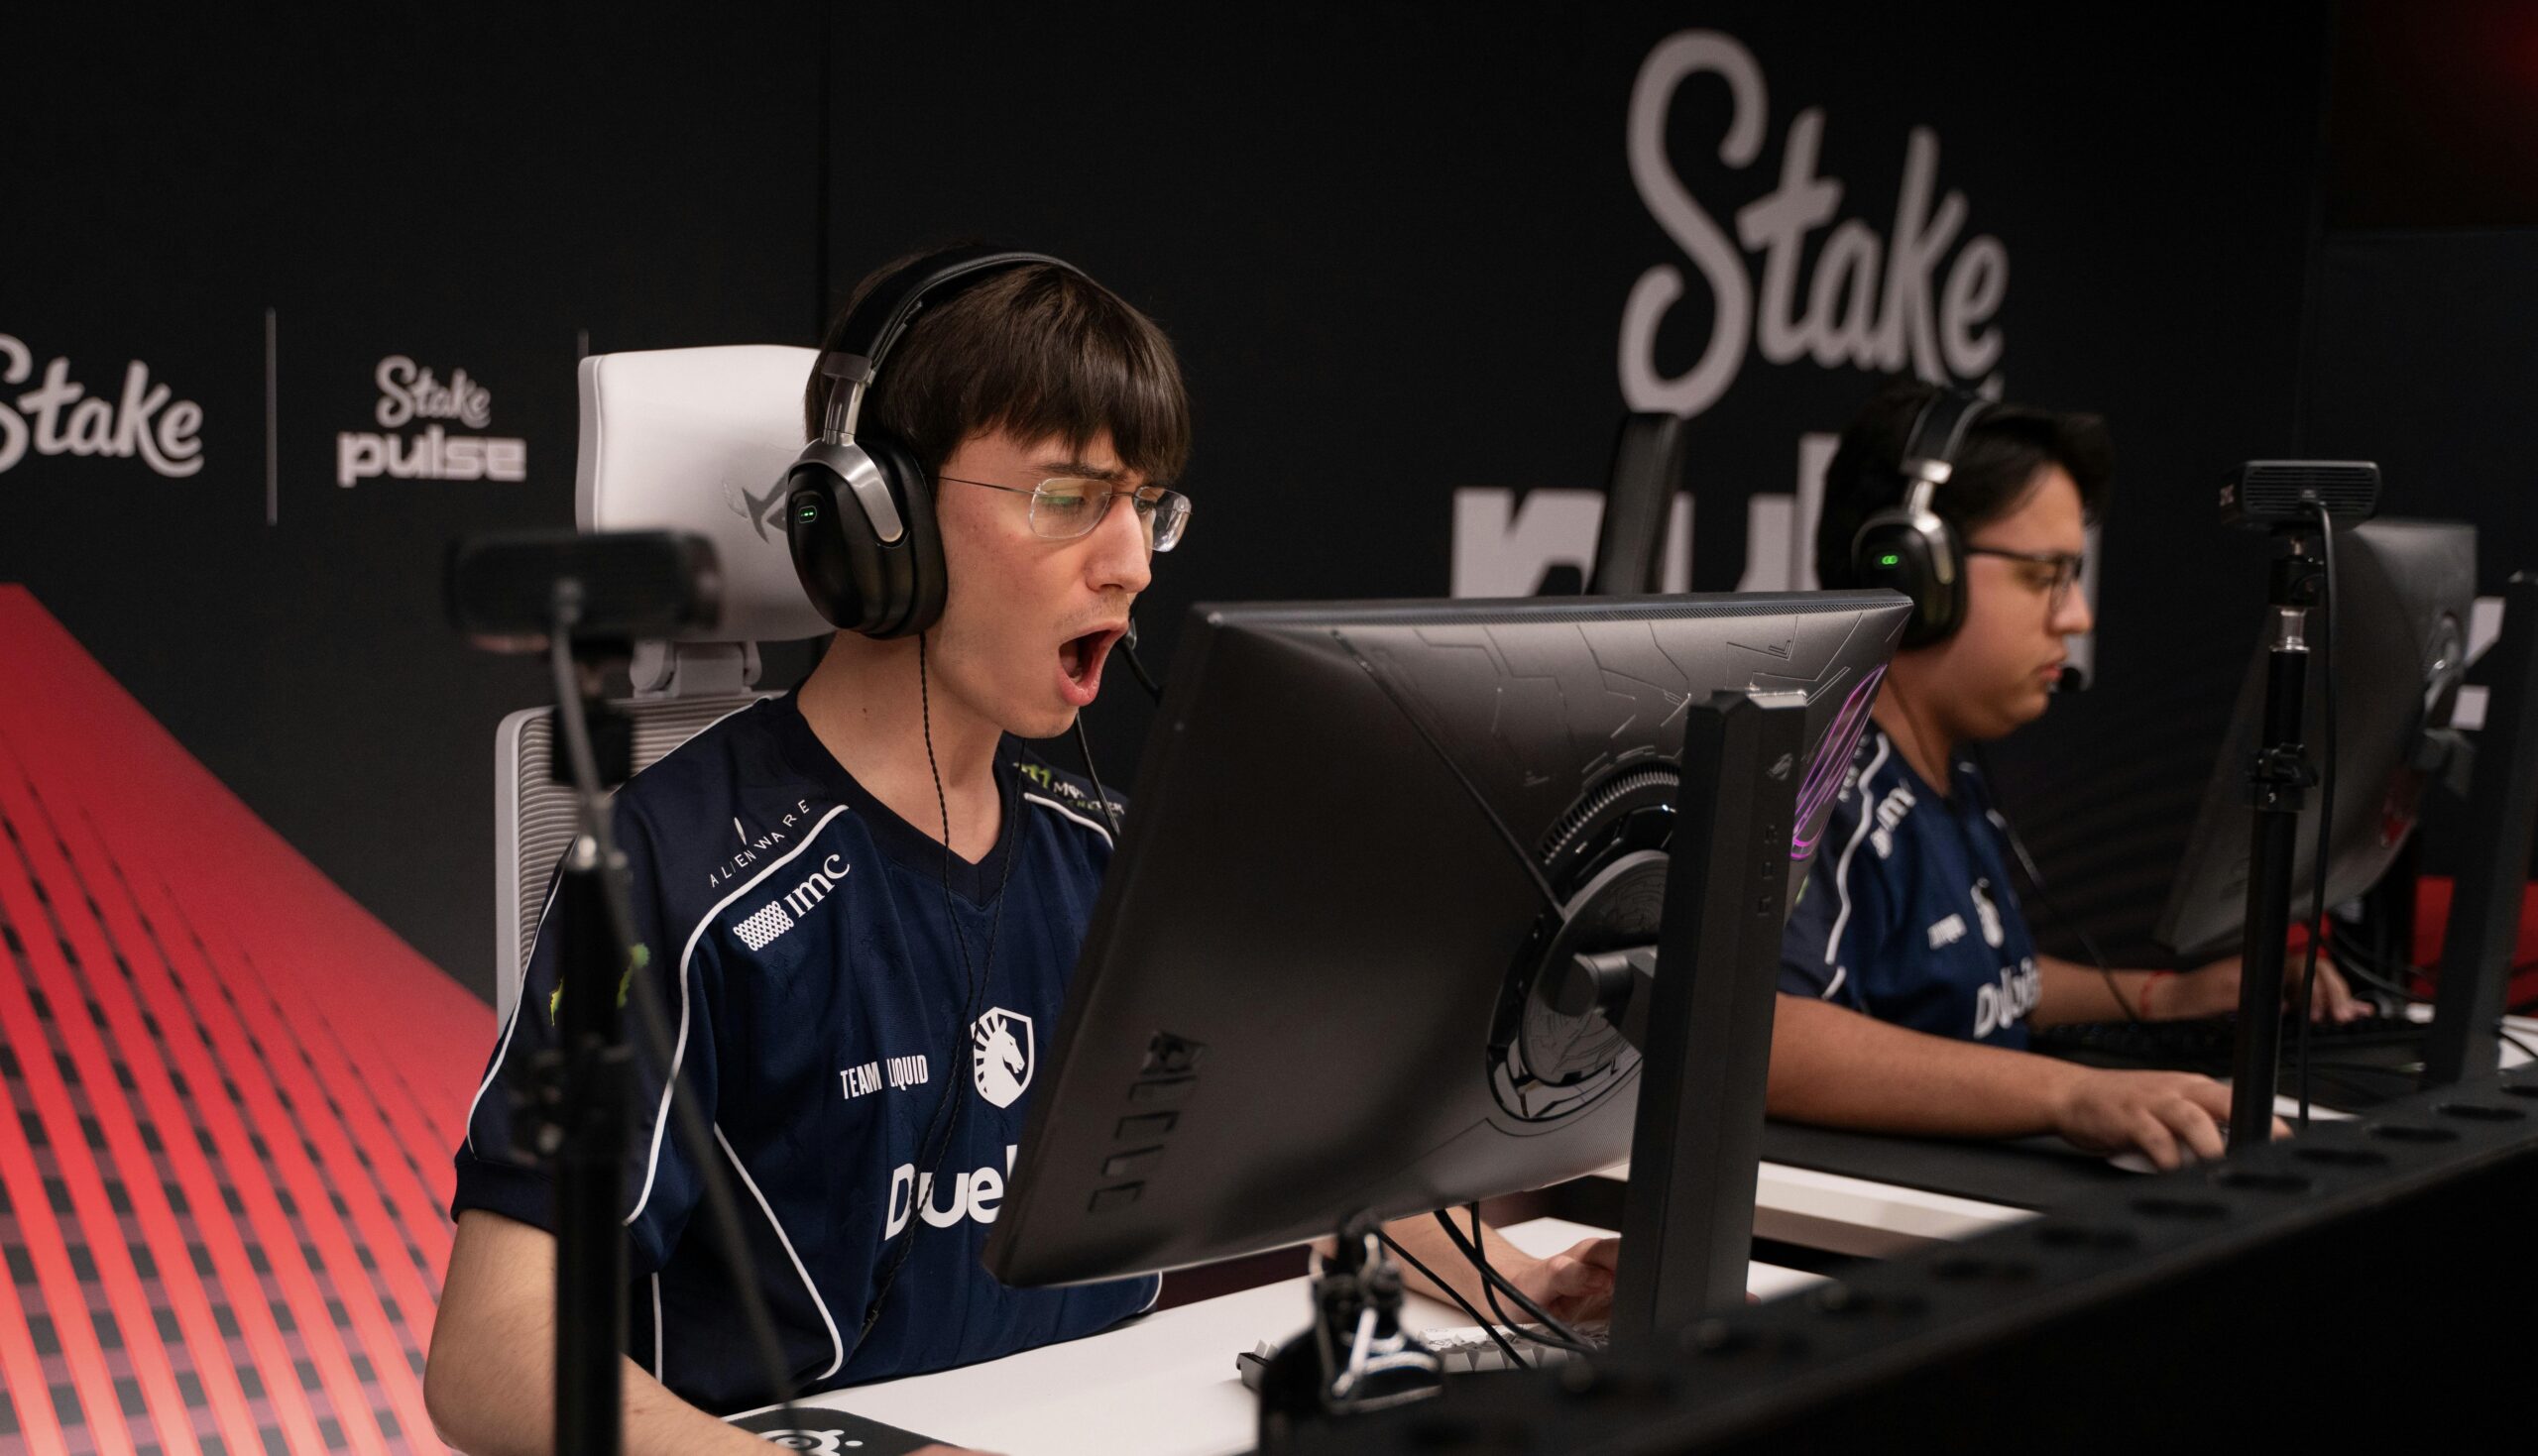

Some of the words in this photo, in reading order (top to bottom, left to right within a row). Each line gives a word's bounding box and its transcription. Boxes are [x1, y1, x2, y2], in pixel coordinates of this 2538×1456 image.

[1617, 29, 2009, 418] Stake
[375, 355, 492, 429] Stake
[336, 423, 527, 488] pulse
[708, 799, 810, 888] ALIENWARE
[840, 1061, 883, 1100] TEAM
[886, 1054, 929, 1091] LIQUID
